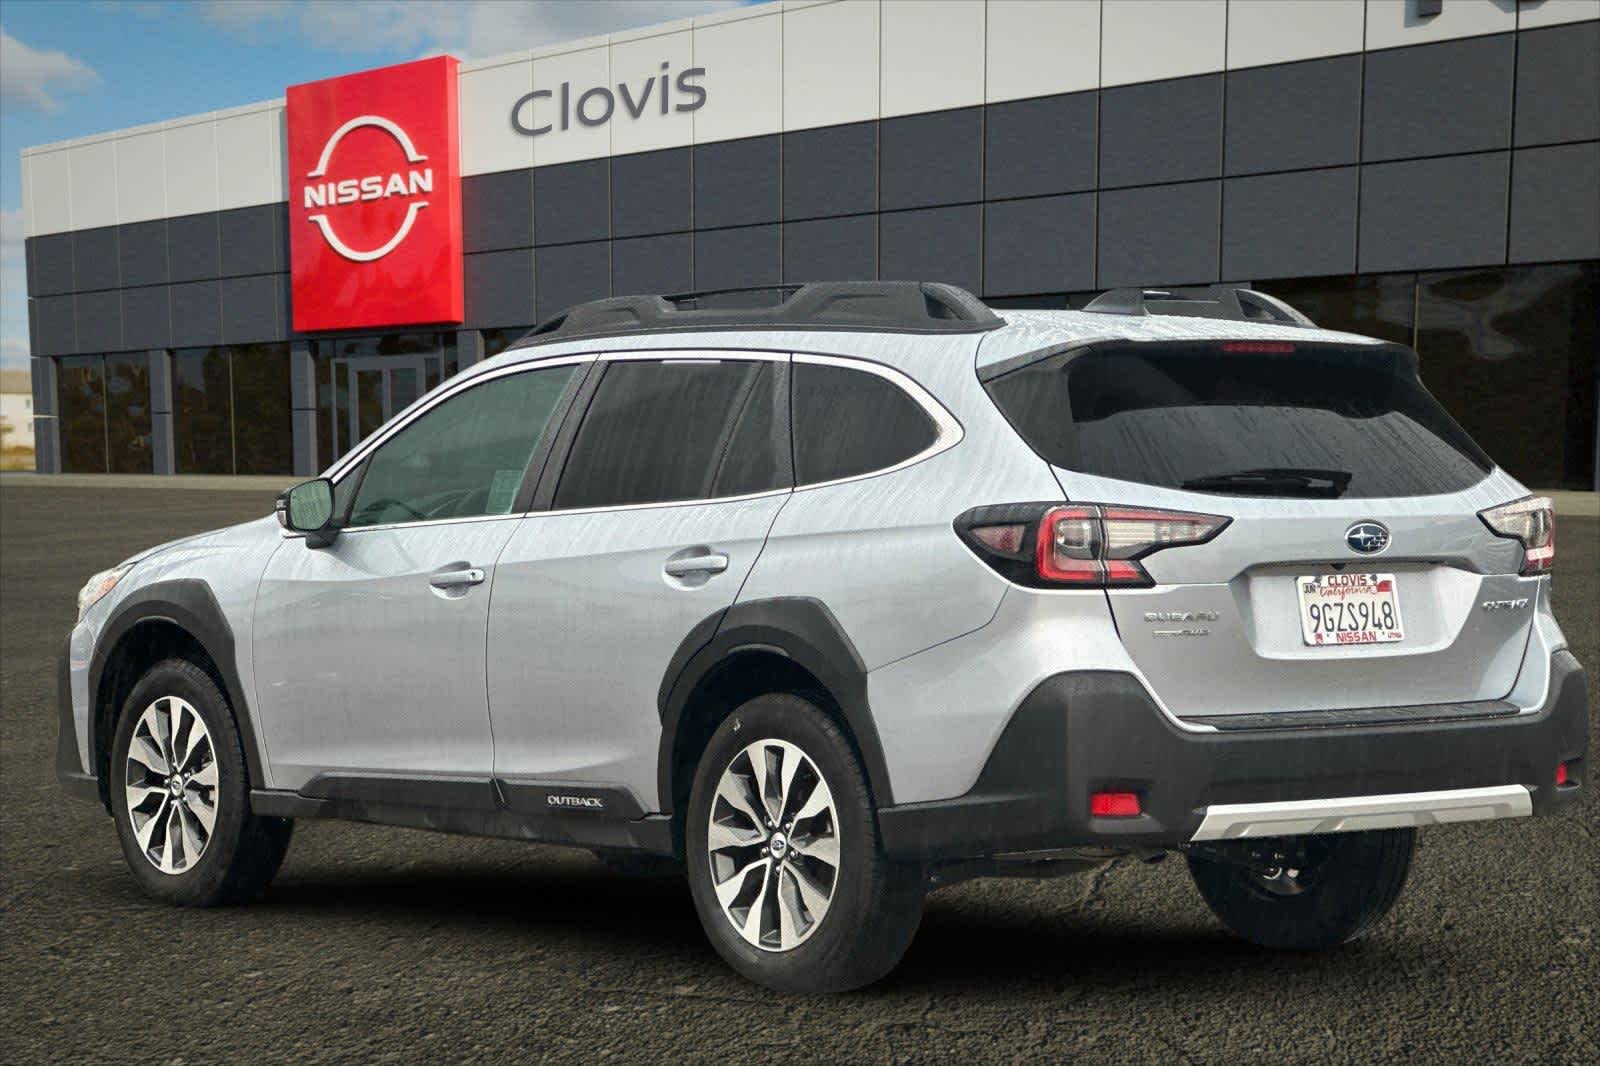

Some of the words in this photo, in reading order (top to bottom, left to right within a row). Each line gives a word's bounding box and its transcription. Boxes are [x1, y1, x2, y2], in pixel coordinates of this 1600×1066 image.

[511, 61, 706, 136] Clovis
[303, 167, 433, 209] NISSAN
[1327, 574, 1367, 587] CLOVIS
[1309, 600, 1395, 633] 9GZS948
[1336, 631, 1377, 643] NISSAN
[547, 795, 603, 807] OUTBACK
